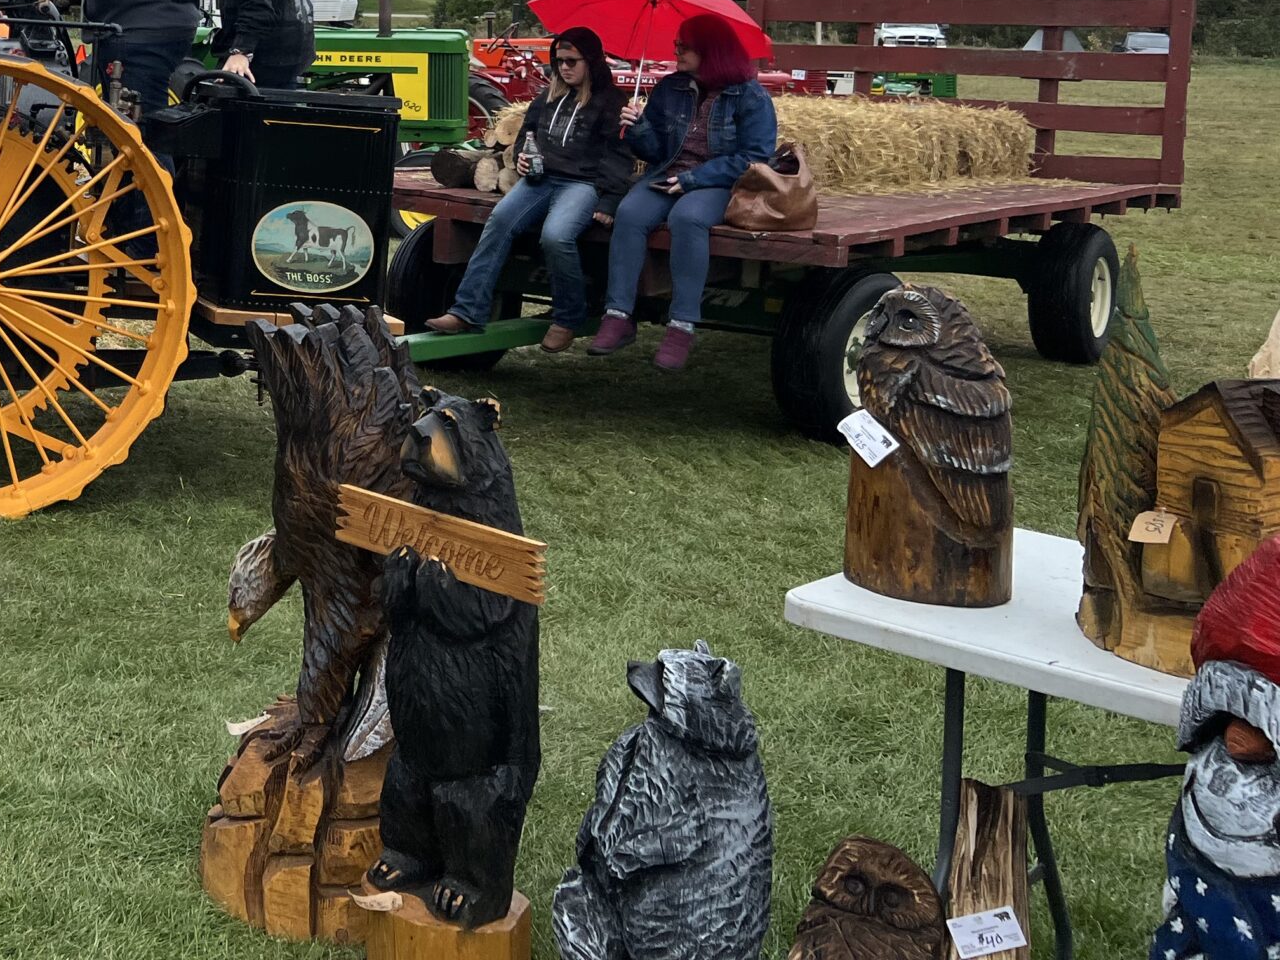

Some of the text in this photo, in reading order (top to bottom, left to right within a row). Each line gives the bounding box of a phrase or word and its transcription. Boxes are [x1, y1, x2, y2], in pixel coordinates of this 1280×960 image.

[316, 54, 382, 63] HN DEERE
[403, 100, 422, 113] 620
[285, 272, 303, 282] THE
[363, 501, 505, 580] Welcome
[978, 933, 1003, 948] $40
